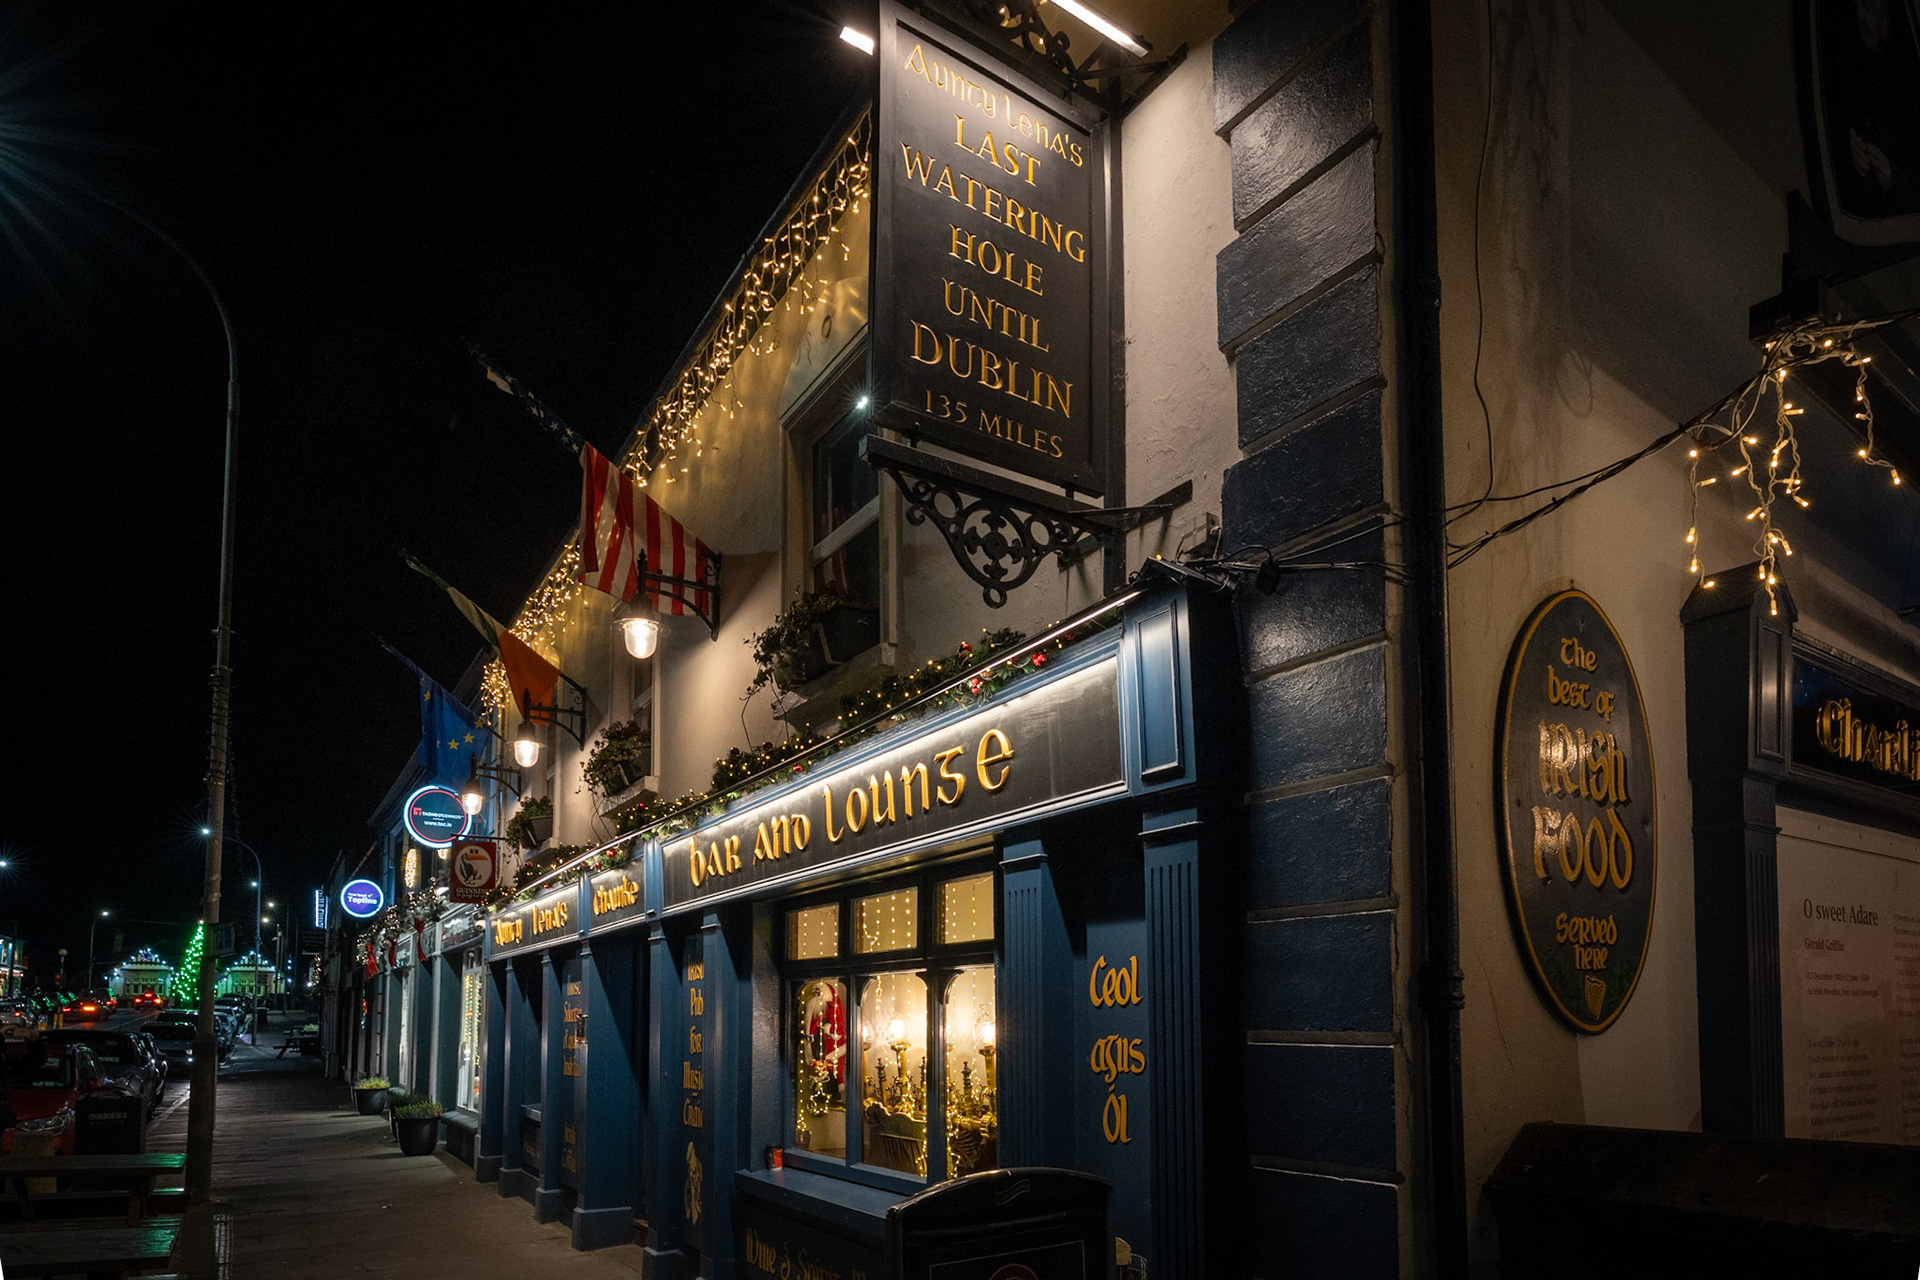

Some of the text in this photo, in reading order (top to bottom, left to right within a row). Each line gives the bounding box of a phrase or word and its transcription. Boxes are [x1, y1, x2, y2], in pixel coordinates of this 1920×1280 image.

[904, 44, 996, 119] Aunty
[953, 112, 1041, 188] LAST
[900, 141, 1086, 263] WATERING
[949, 223, 1043, 296] HOLE
[942, 277, 1049, 353] UNTIL
[910, 319, 1073, 419] DUBLIN
[925, 389, 1063, 459] 135 MILES
[1561, 637, 1598, 672] The
[1547, 665, 1615, 724] best of
[347, 896, 378, 905] Topline
[455, 887, 488, 895] GUINNES
[1803, 898, 1813, 919] O
[1815, 904, 1847, 923] sweet
[1848, 904, 1879, 926] Adare
[690, 987, 704, 1017] Pub
[1089, 955, 1143, 1007] Ceol
